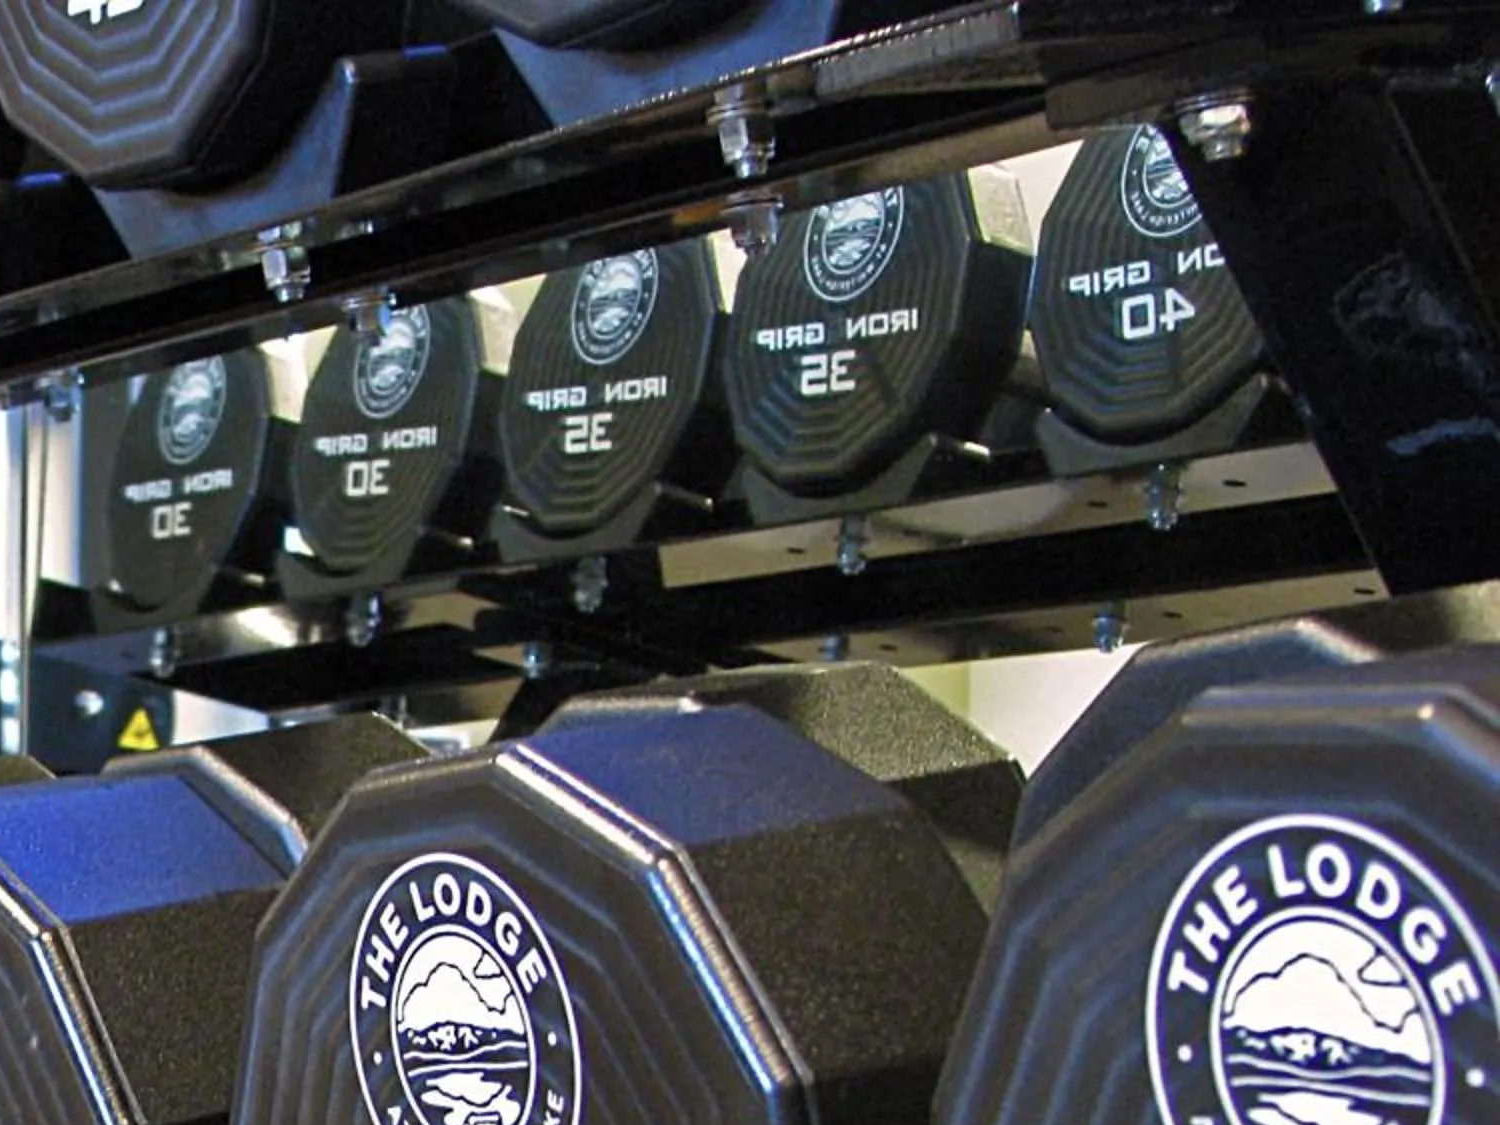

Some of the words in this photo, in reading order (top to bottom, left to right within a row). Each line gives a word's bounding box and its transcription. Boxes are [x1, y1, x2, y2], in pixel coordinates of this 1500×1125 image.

[361, 902, 409, 1010] THE
[410, 873, 547, 994] LODGE
[1167, 865, 1258, 993] THE
[1268, 842, 1481, 1015] LODGE
